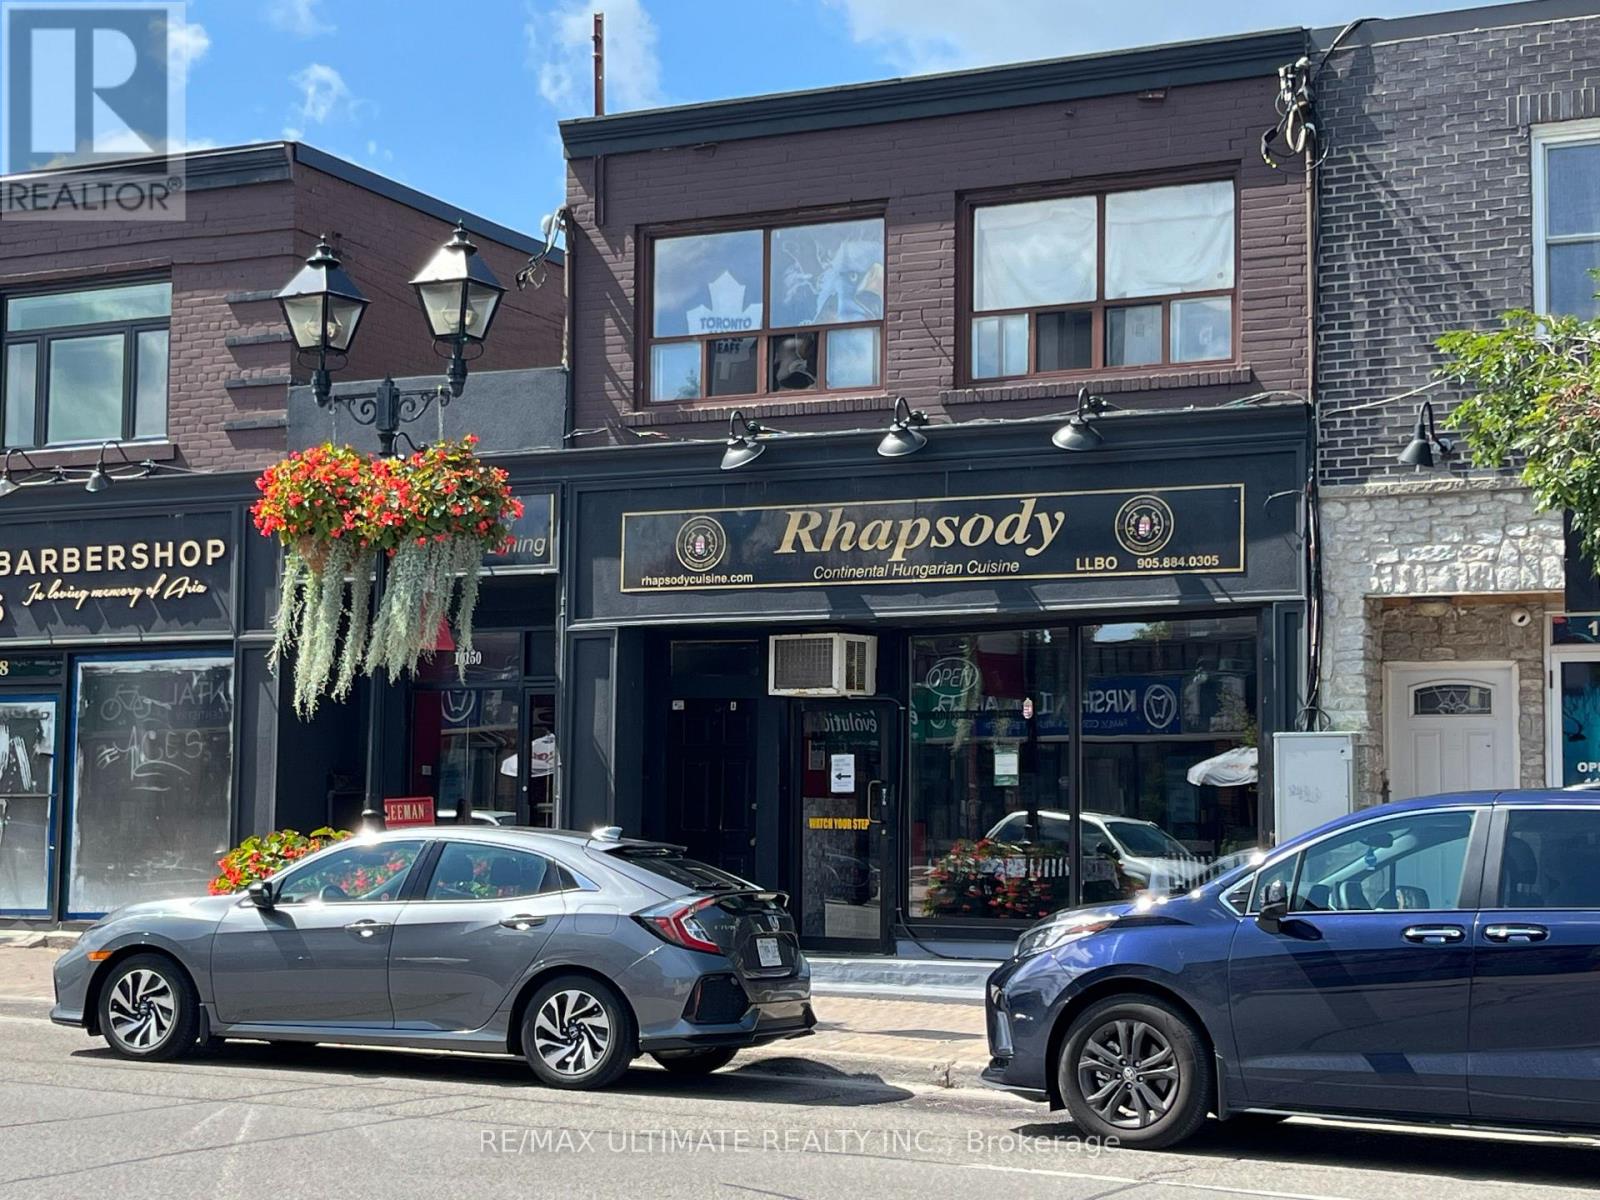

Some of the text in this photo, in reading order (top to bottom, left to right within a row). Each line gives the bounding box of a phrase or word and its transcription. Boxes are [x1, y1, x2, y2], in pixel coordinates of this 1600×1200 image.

[700, 316, 752, 330] TORONTO
[775, 497, 1065, 562] Rhapsody
[813, 559, 1020, 580] Continental Hungarian Cuisine
[1076, 555, 1219, 571] LLBO 905.884.0305
[641, 572, 753, 588] rhapsodycuisine.com
[22, 582, 44, 606] In
[47, 579, 90, 610] loving
[91, 586, 144, 608] memory
[145, 573, 167, 599] of
[928, 667, 974, 689] OPEN
[1577, 761, 1600, 773] OP
[809, 817, 870, 830] WATCH YOUR STEP
